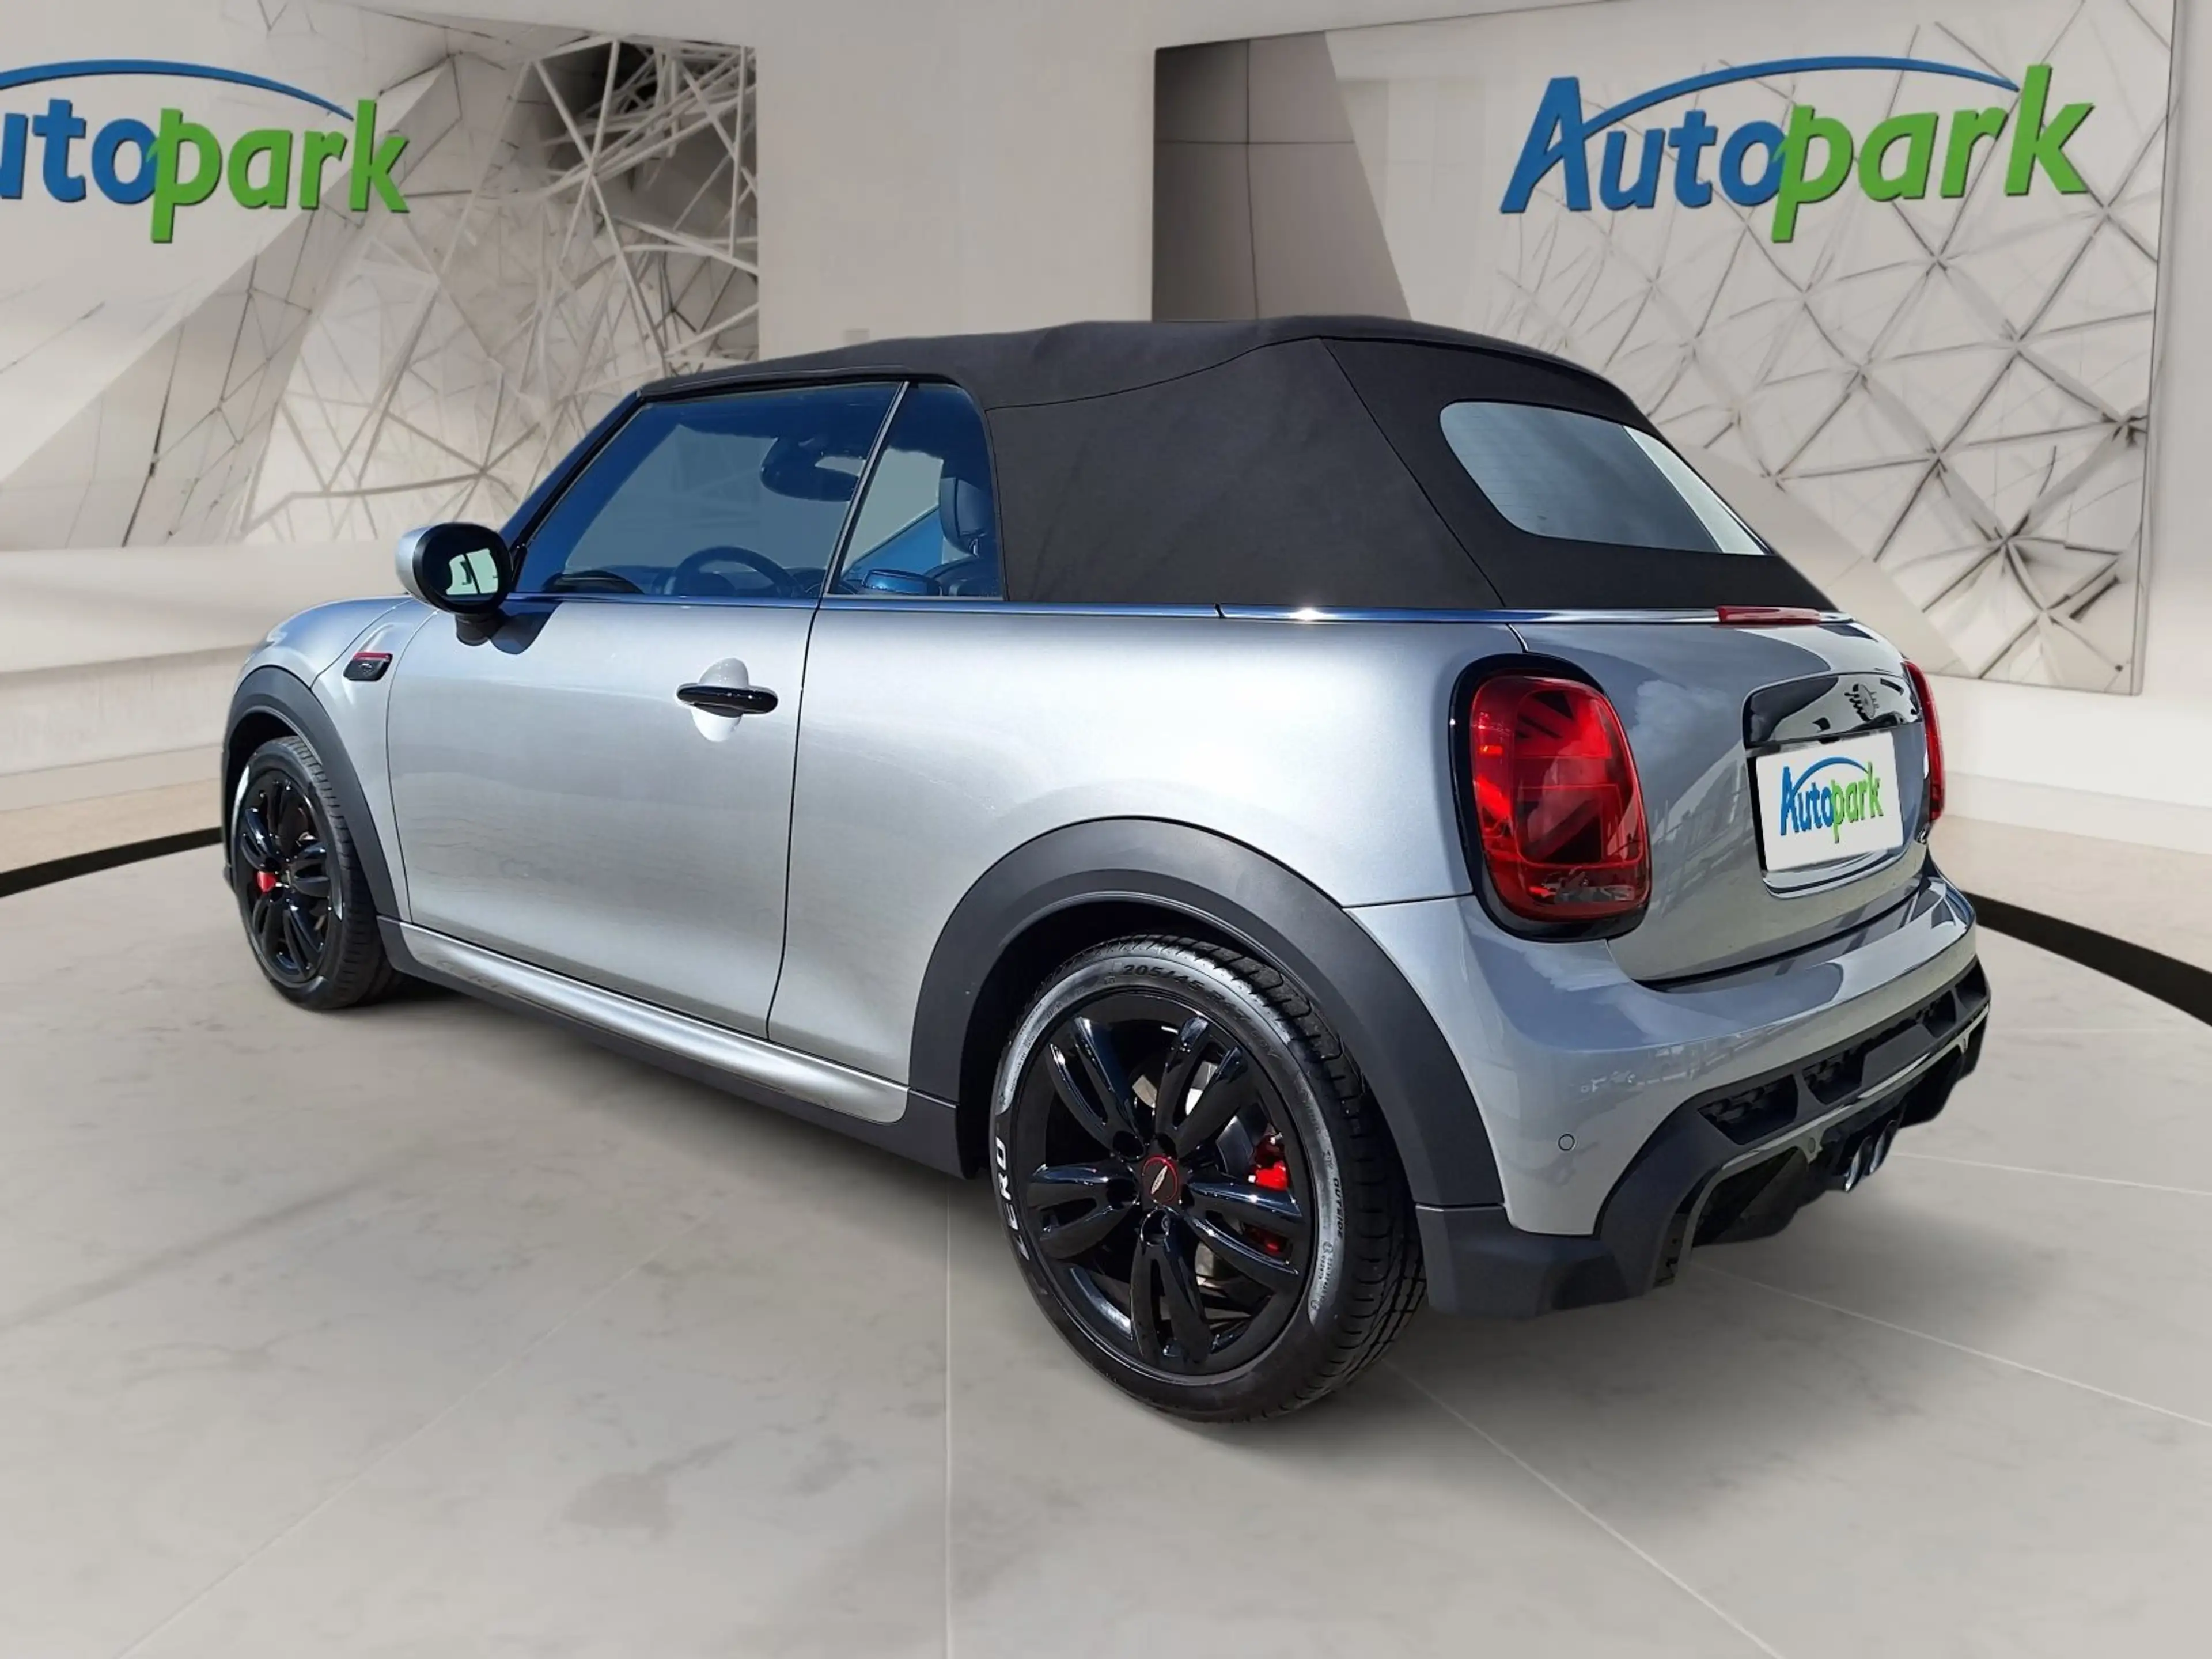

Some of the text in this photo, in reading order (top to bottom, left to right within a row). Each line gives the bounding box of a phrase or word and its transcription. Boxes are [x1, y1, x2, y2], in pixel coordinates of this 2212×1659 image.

[1499, 63, 2095, 243] Autopark
[1780, 761, 1883, 843] Autopark
[1332, 1177, 1345, 1241] OUTSIDE
